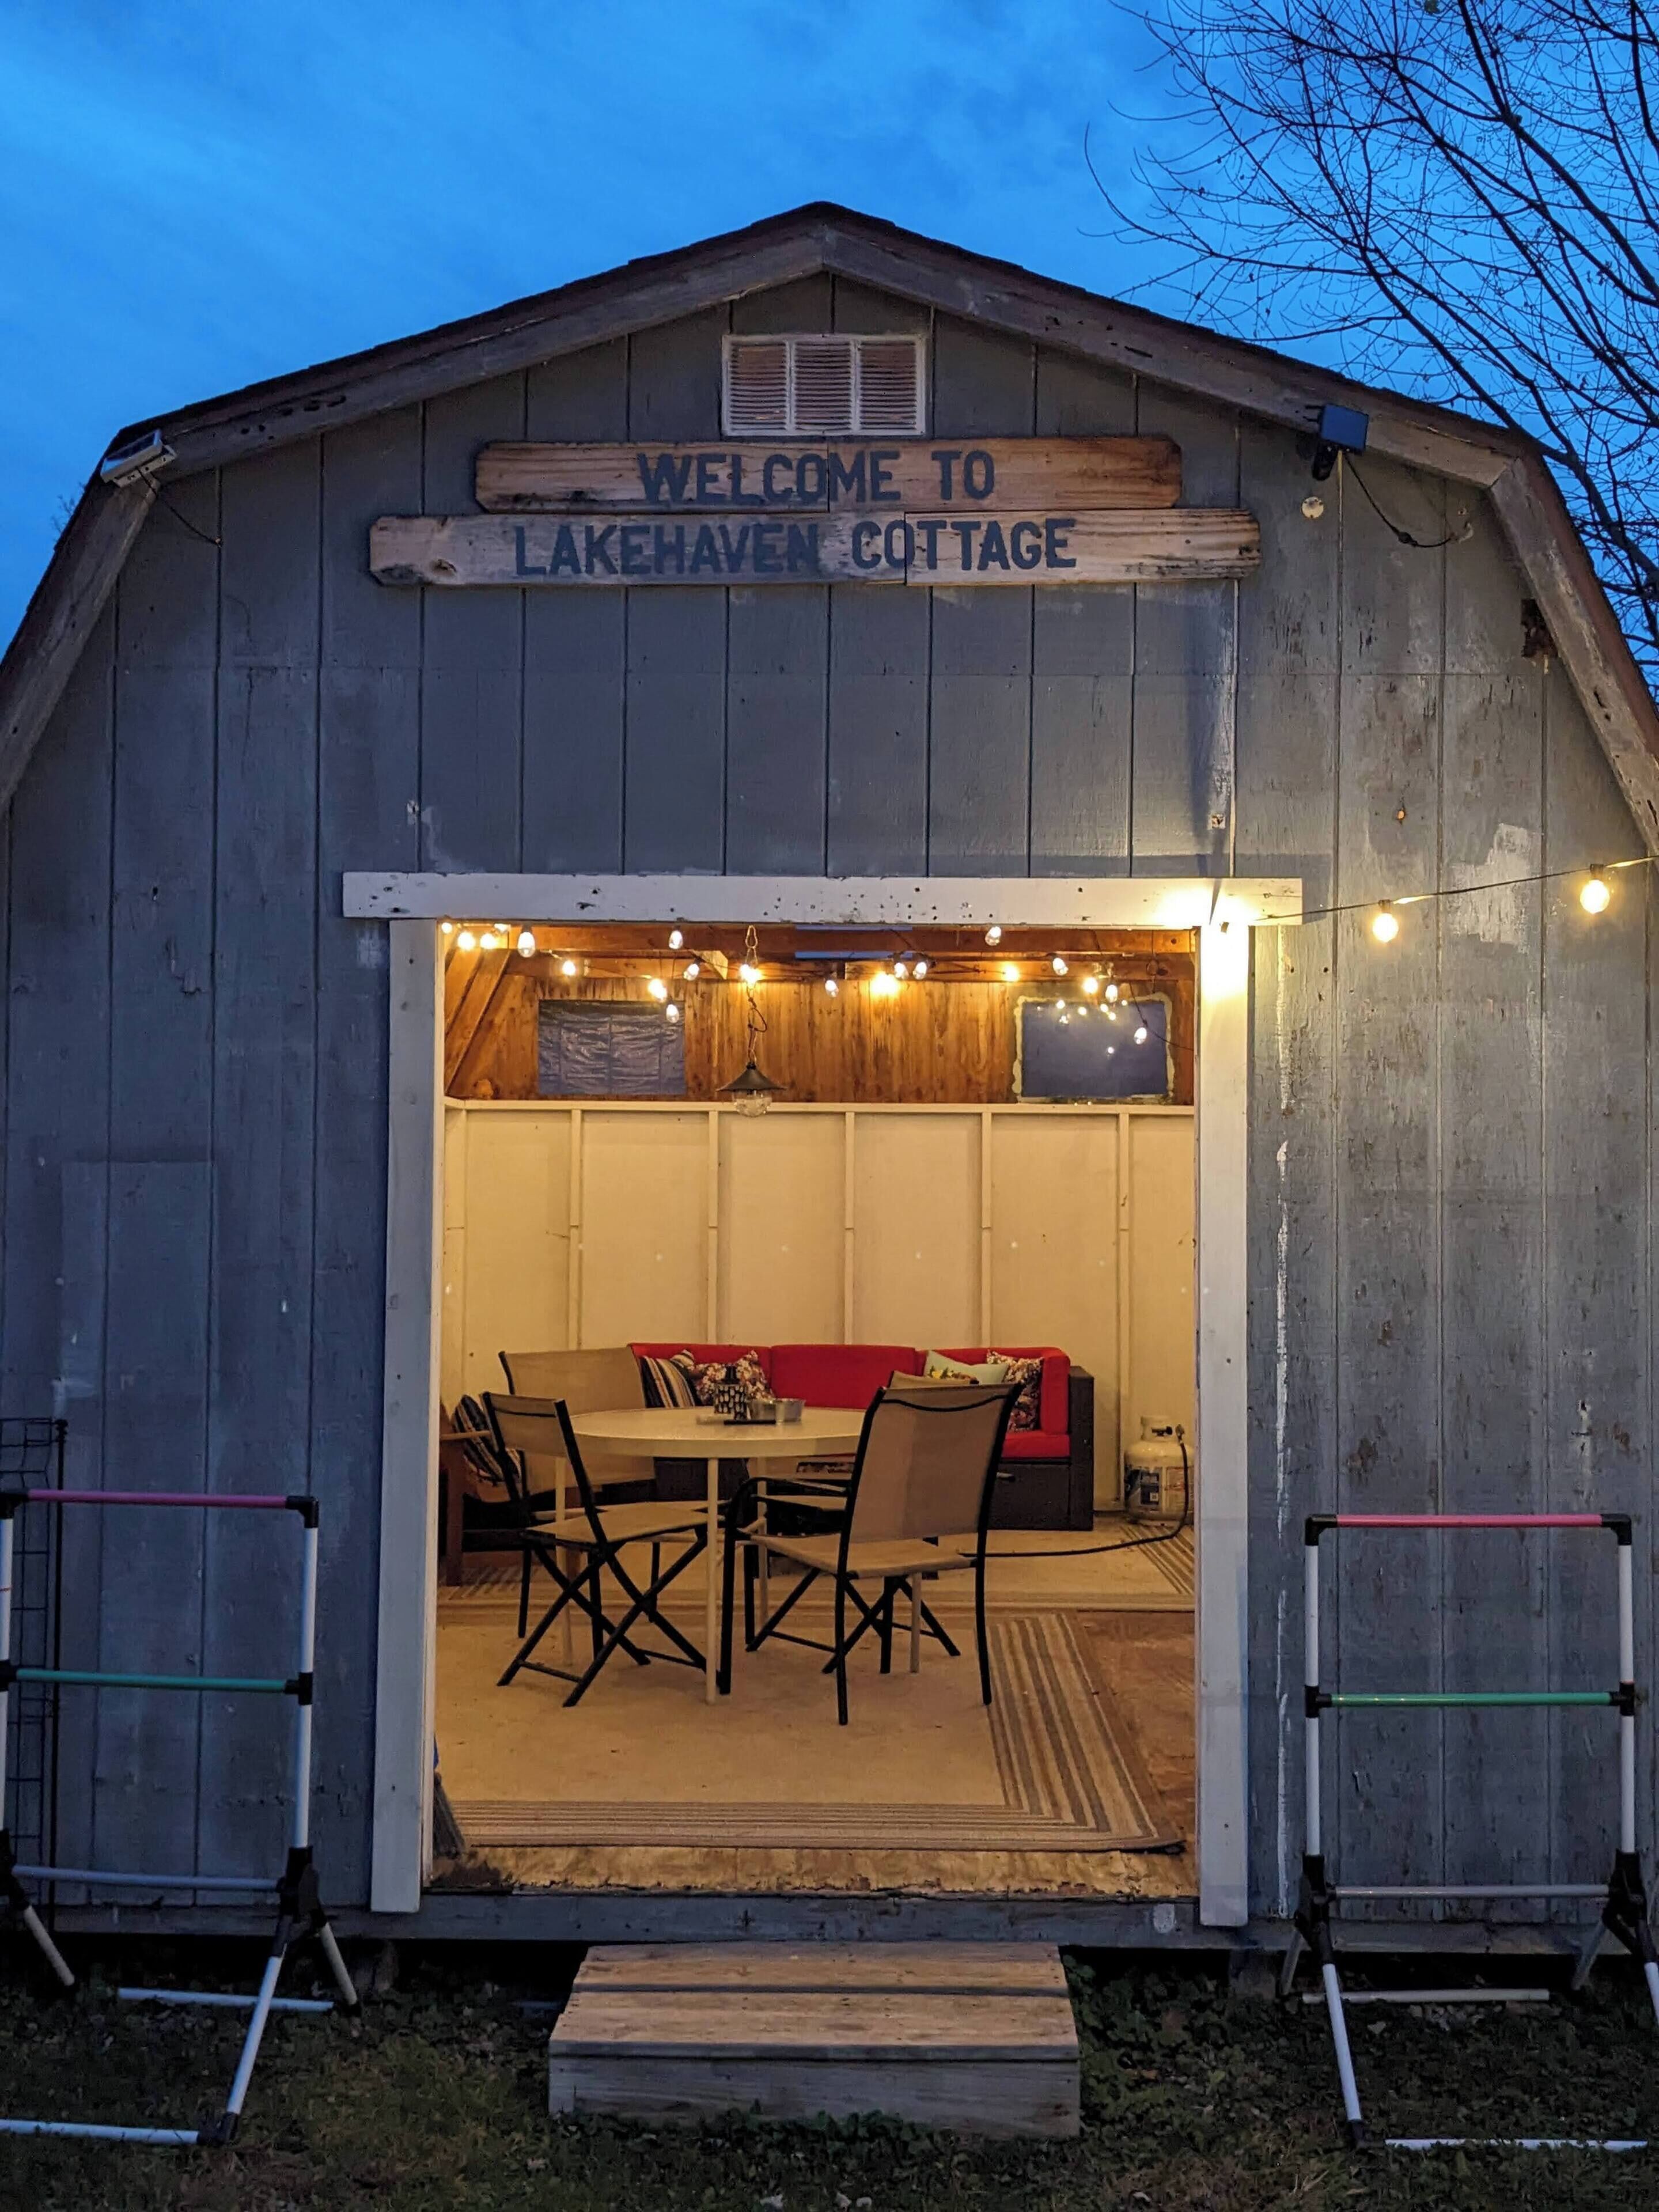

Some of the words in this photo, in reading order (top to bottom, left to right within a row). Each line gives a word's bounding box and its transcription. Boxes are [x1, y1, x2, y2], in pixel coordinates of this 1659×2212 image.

[638, 452, 901, 503] WELCOME
[931, 450, 995, 500] TO
[516, 524, 819, 575] LAKEHAVEN
[852, 518, 1077, 571] COTTAGE
